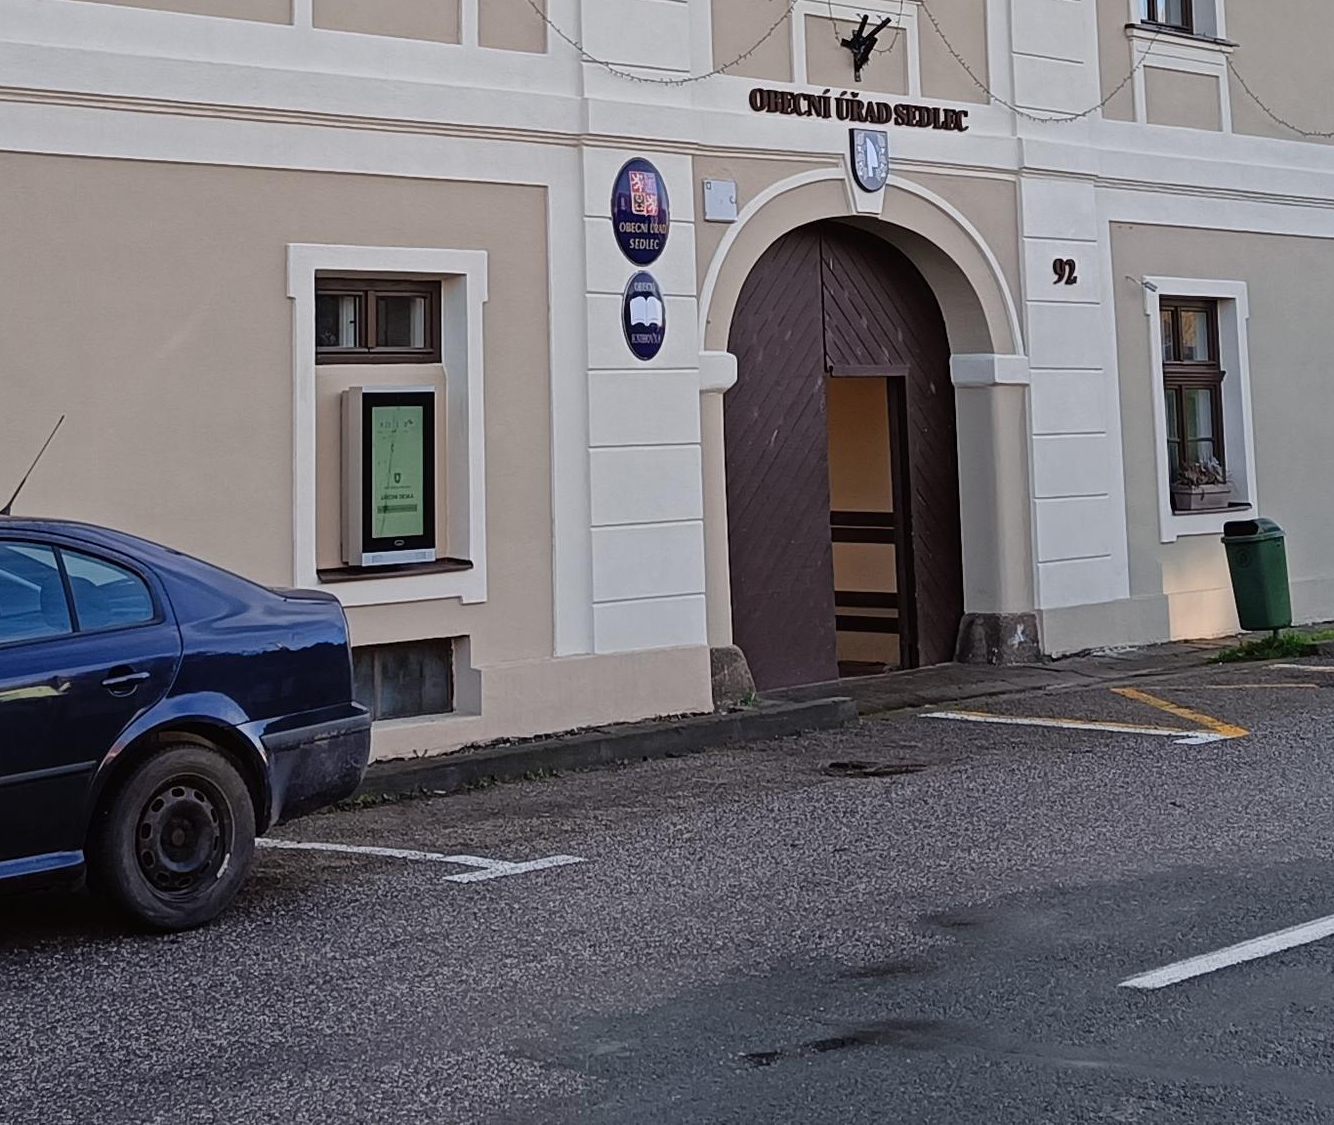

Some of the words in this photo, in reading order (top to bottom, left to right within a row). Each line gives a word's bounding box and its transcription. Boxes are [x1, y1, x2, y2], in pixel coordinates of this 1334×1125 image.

[749, 88, 831, 119] OBECNÍ
[834, 90, 892, 124] ÚŘAD
[893, 103, 969, 132] SEDLEC
[629, 238, 660, 250] SEDLEC
[1052, 258, 1078, 285] 92
